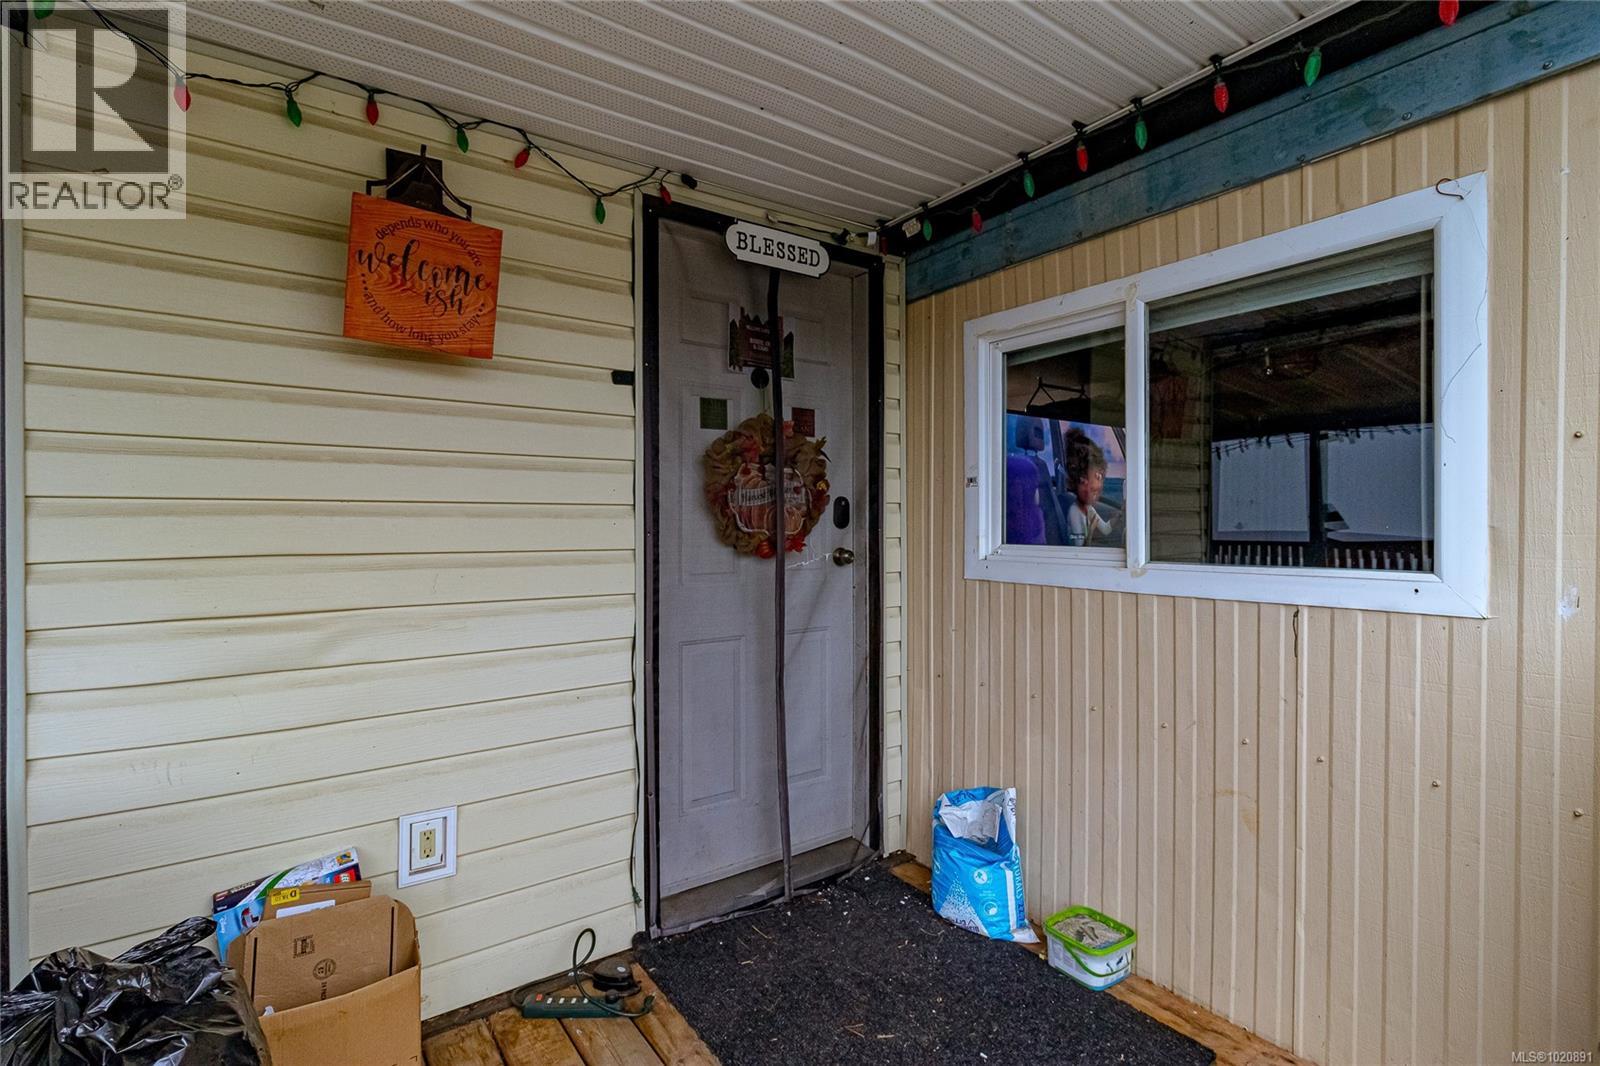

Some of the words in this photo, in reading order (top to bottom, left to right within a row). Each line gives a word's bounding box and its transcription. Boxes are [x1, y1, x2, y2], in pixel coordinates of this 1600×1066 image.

[375, 216, 422, 240] depends
[422, 219, 450, 235] who
[449, 230, 471, 250] you
[466, 247, 484, 267] are
[735, 231, 821, 268] BLESSED
[356, 238, 488, 296] welcome
[424, 285, 463, 317] ish
[380, 311, 408, 334] how
[407, 325, 437, 345] long
[437, 327, 460, 345] you
